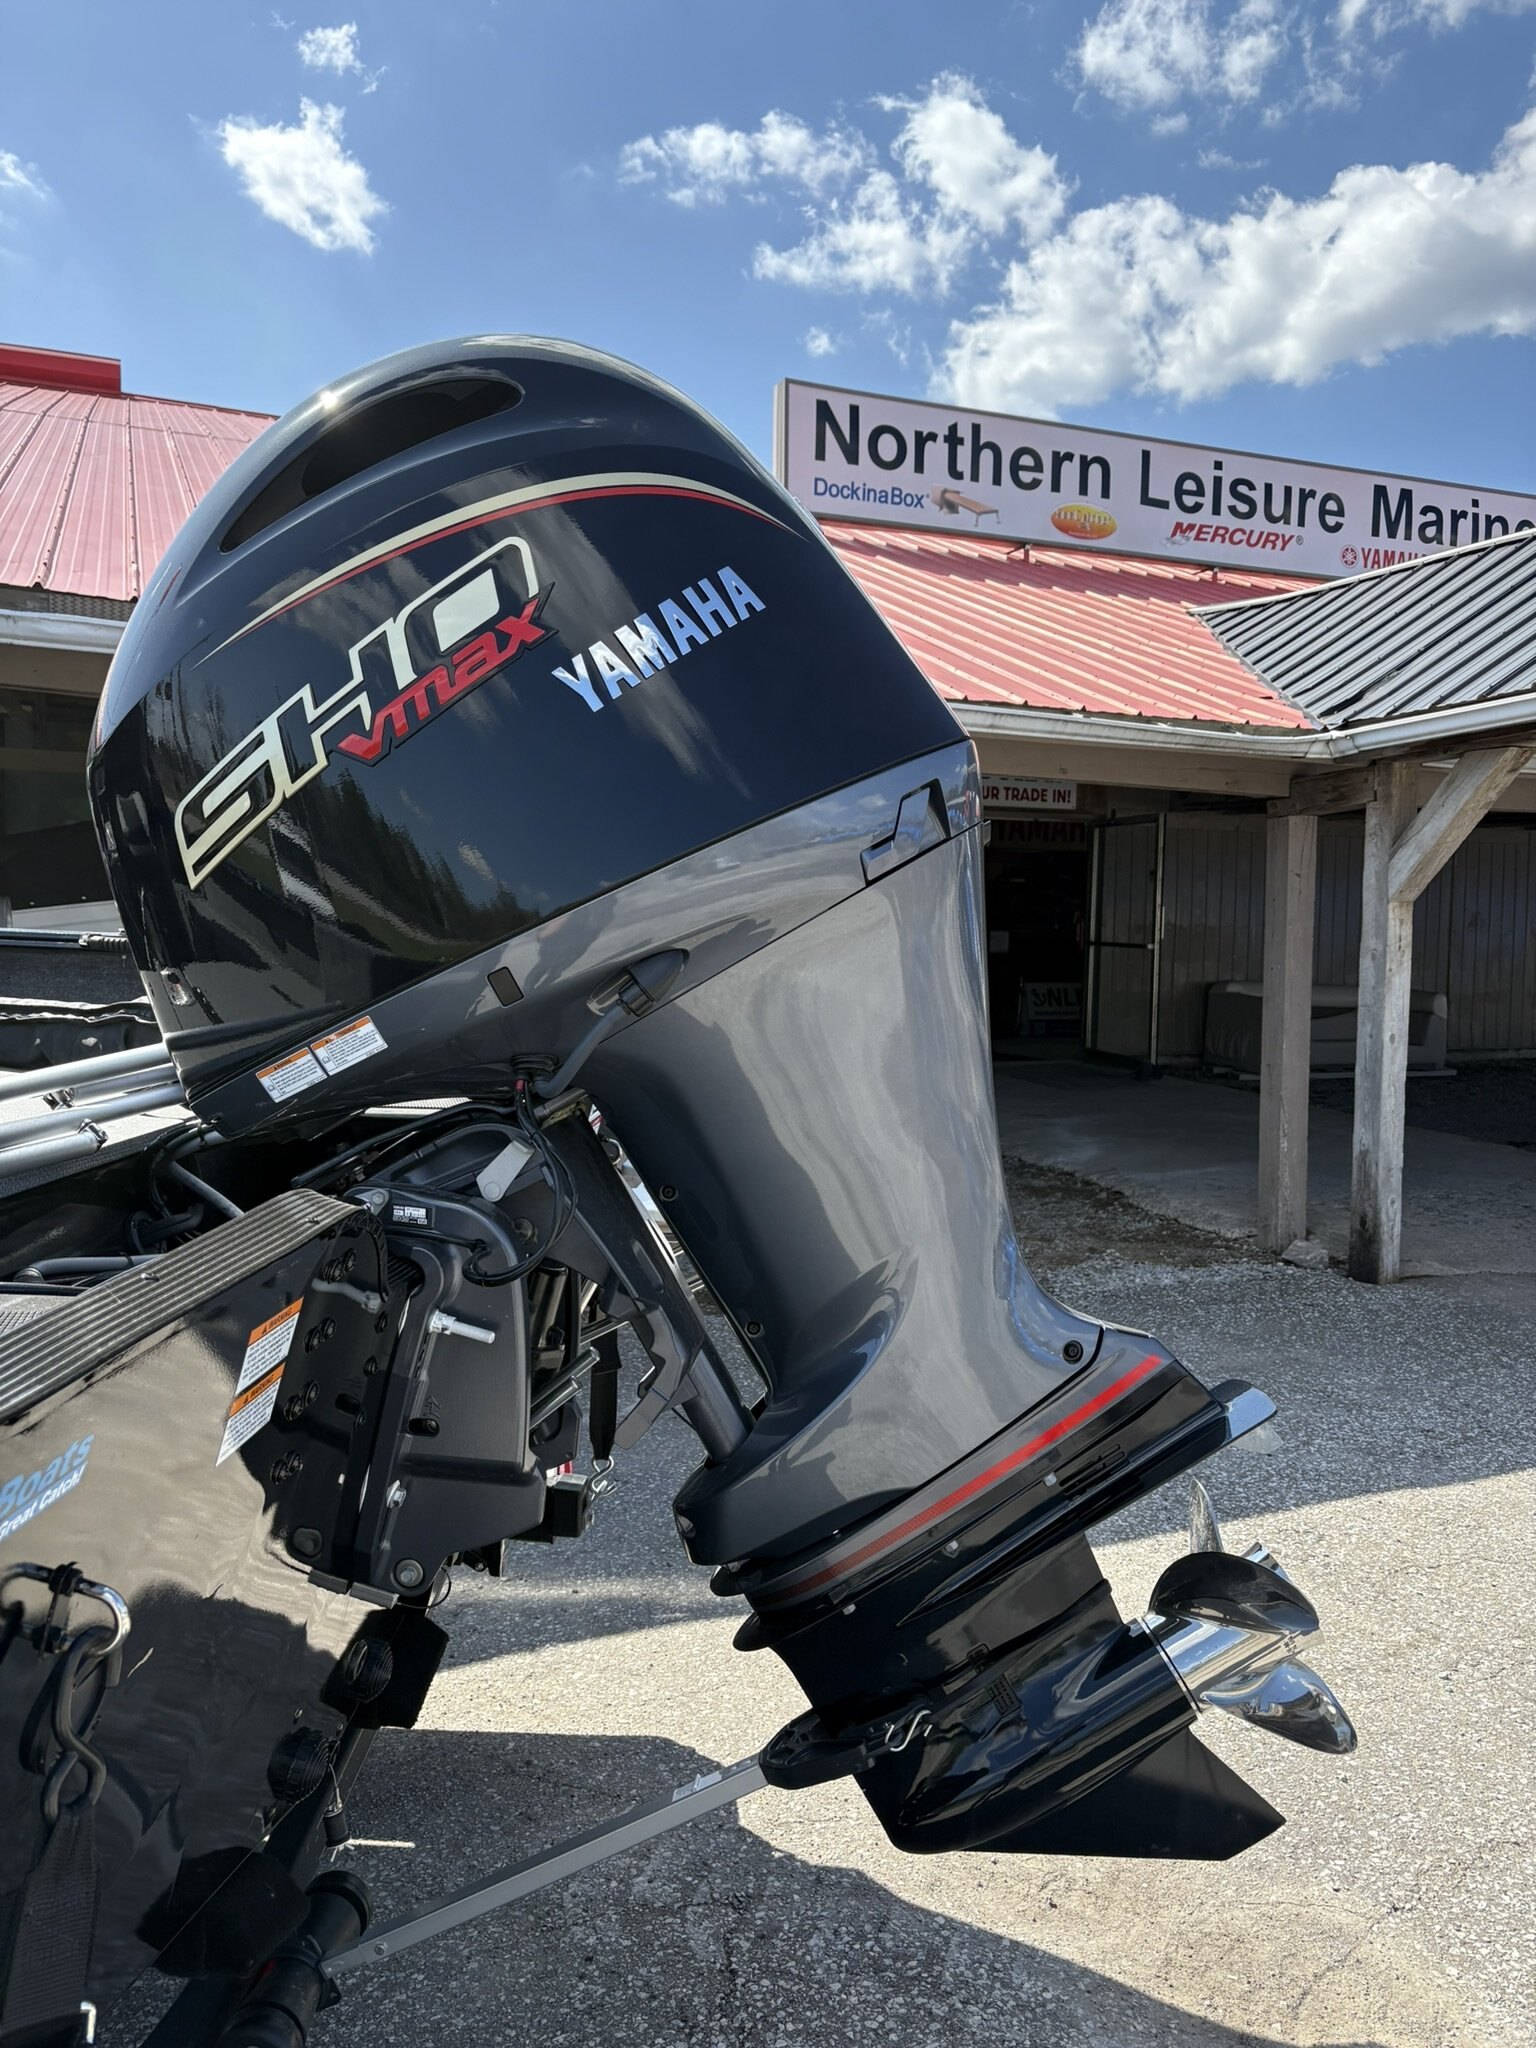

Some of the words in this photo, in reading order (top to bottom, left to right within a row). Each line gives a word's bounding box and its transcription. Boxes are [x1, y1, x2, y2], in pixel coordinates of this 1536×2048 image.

[814, 398, 1111, 500] Northern
[1140, 449, 1345, 534] Leisure
[814, 477, 925, 509] DockinaBox
[551, 566, 767, 713] YAMAHA
[174, 536, 540, 890] SHO
[1003, 786, 1048, 803] TRADE
[1052, 788, 1071, 804] IN!
